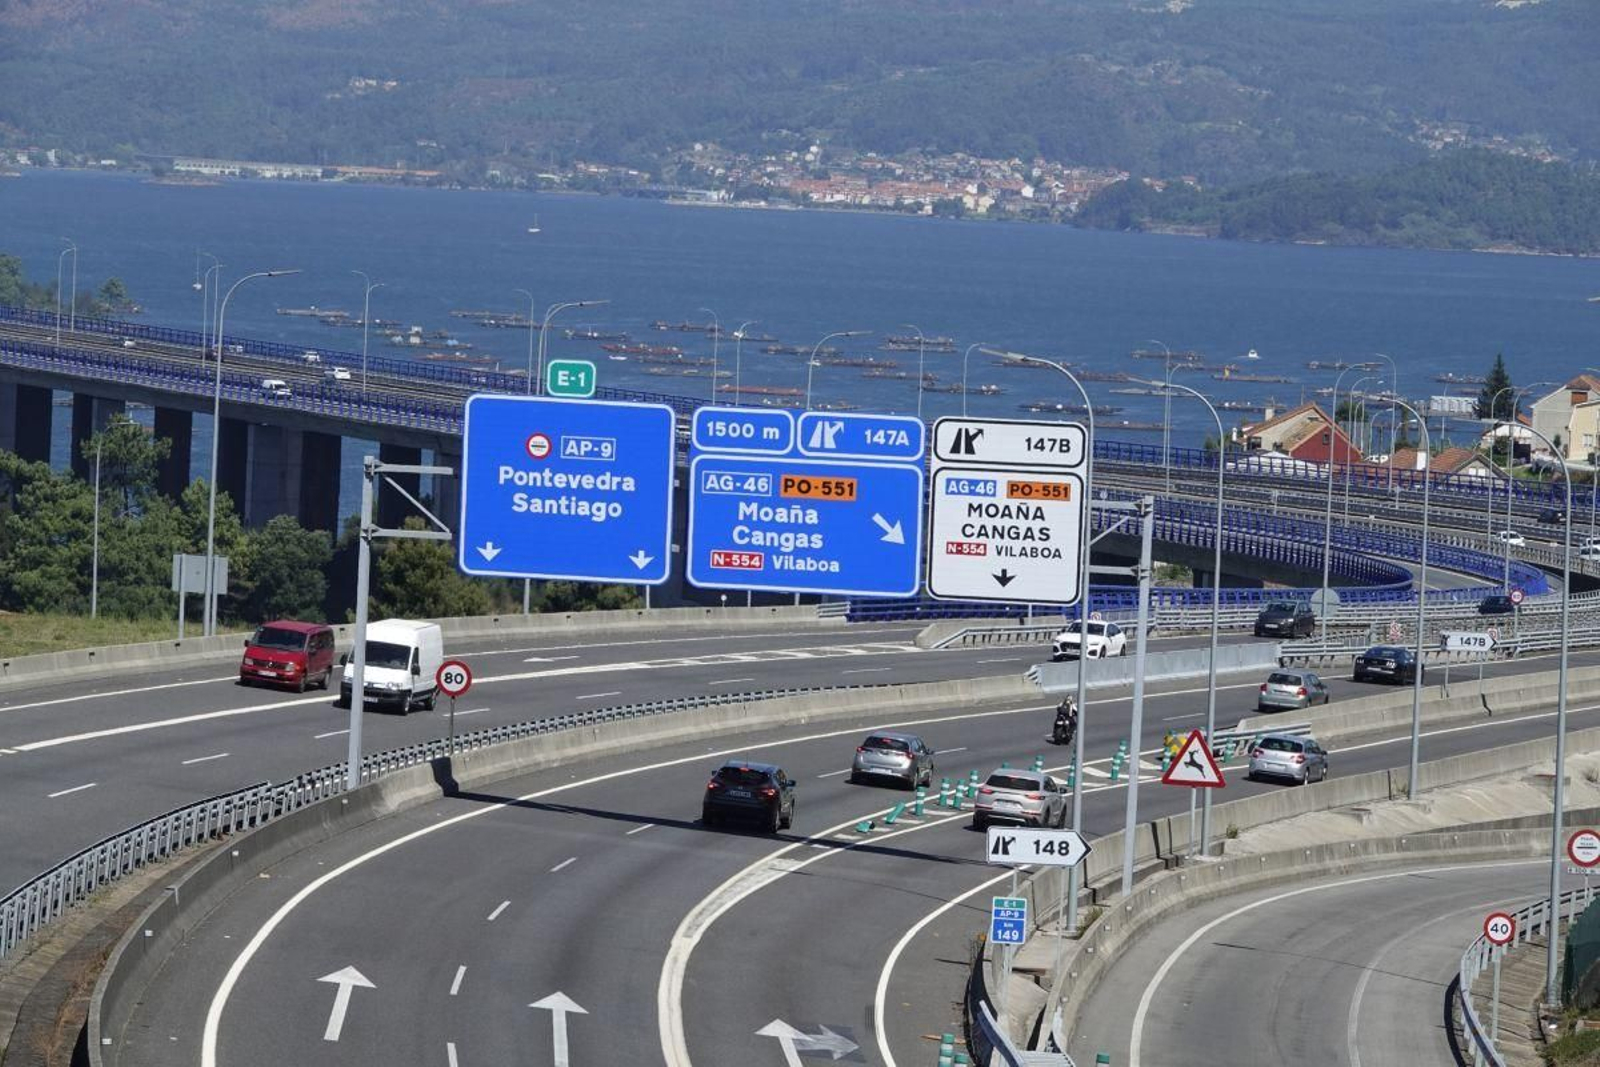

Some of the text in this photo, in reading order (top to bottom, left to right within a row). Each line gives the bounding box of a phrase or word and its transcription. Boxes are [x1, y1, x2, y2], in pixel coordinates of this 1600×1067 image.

[557, 370, 586, 387] E-1
[707, 421, 780, 440] 1500 m
[864, 429, 909, 446] 147A
[564, 440, 613, 457] AP-9
[1025, 437, 1071, 453] 147B
[499, 466, 635, 491] Pontevedra
[705, 474, 855, 497] AG-46 PO-551
[947, 480, 1069, 498] AG-46 PO-551
[512, 493, 622, 521] Santiago
[738, 502, 819, 525] Moaña
[967, 502, 1046, 521] MOAÑA
[732, 526, 824, 553] Cangas
[961, 523, 1050, 542] CANGAS
[947, 543, 1062, 559] N-554 VILABOA
[713, 553, 840, 573] N-554 Vilaboa
[444, 672, 464, 684] 80
[1033, 840, 1070, 856] 148
[1000, 910, 1020, 918] AP-9
[997, 930, 1020, 941] 149
[1490, 923, 1509, 935] 40
